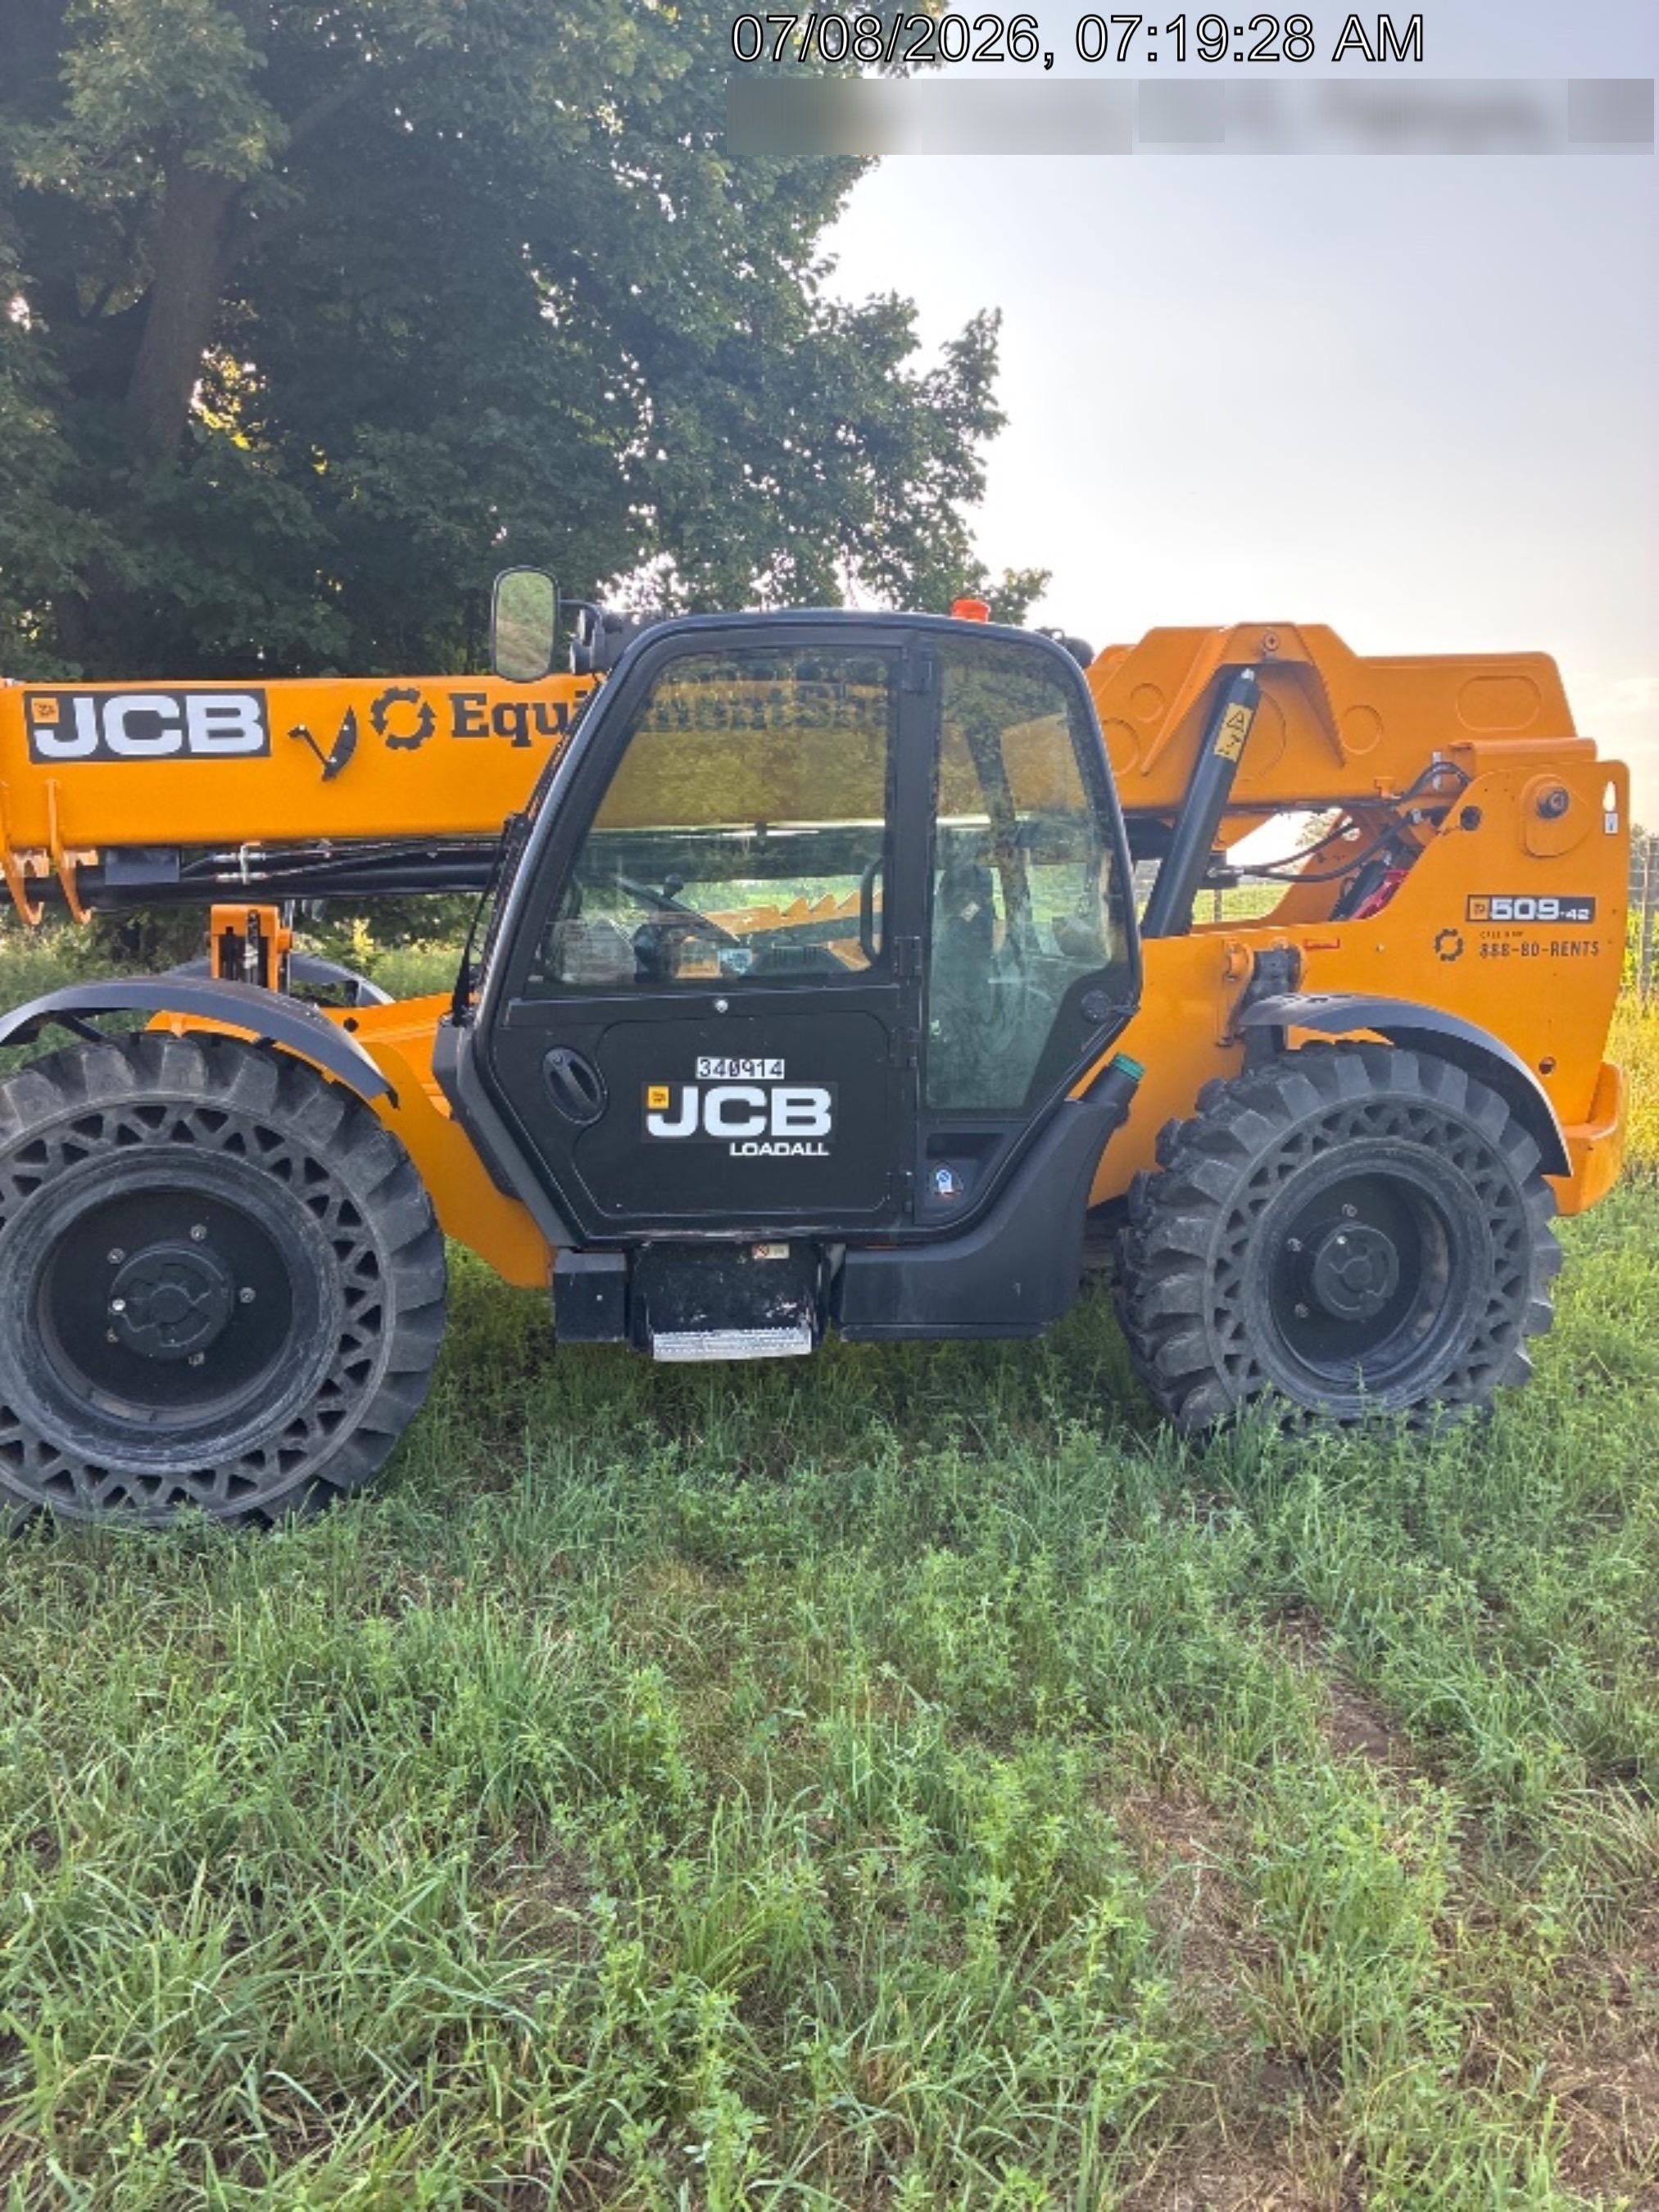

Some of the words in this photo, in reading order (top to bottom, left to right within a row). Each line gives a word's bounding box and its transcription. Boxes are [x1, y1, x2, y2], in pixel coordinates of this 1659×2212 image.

[34, 694, 264, 758] JCB
[700, 1058, 783, 1078] 340914
[647, 1086, 832, 1138] JCB
[729, 1142, 831, 1157] LOADALL
